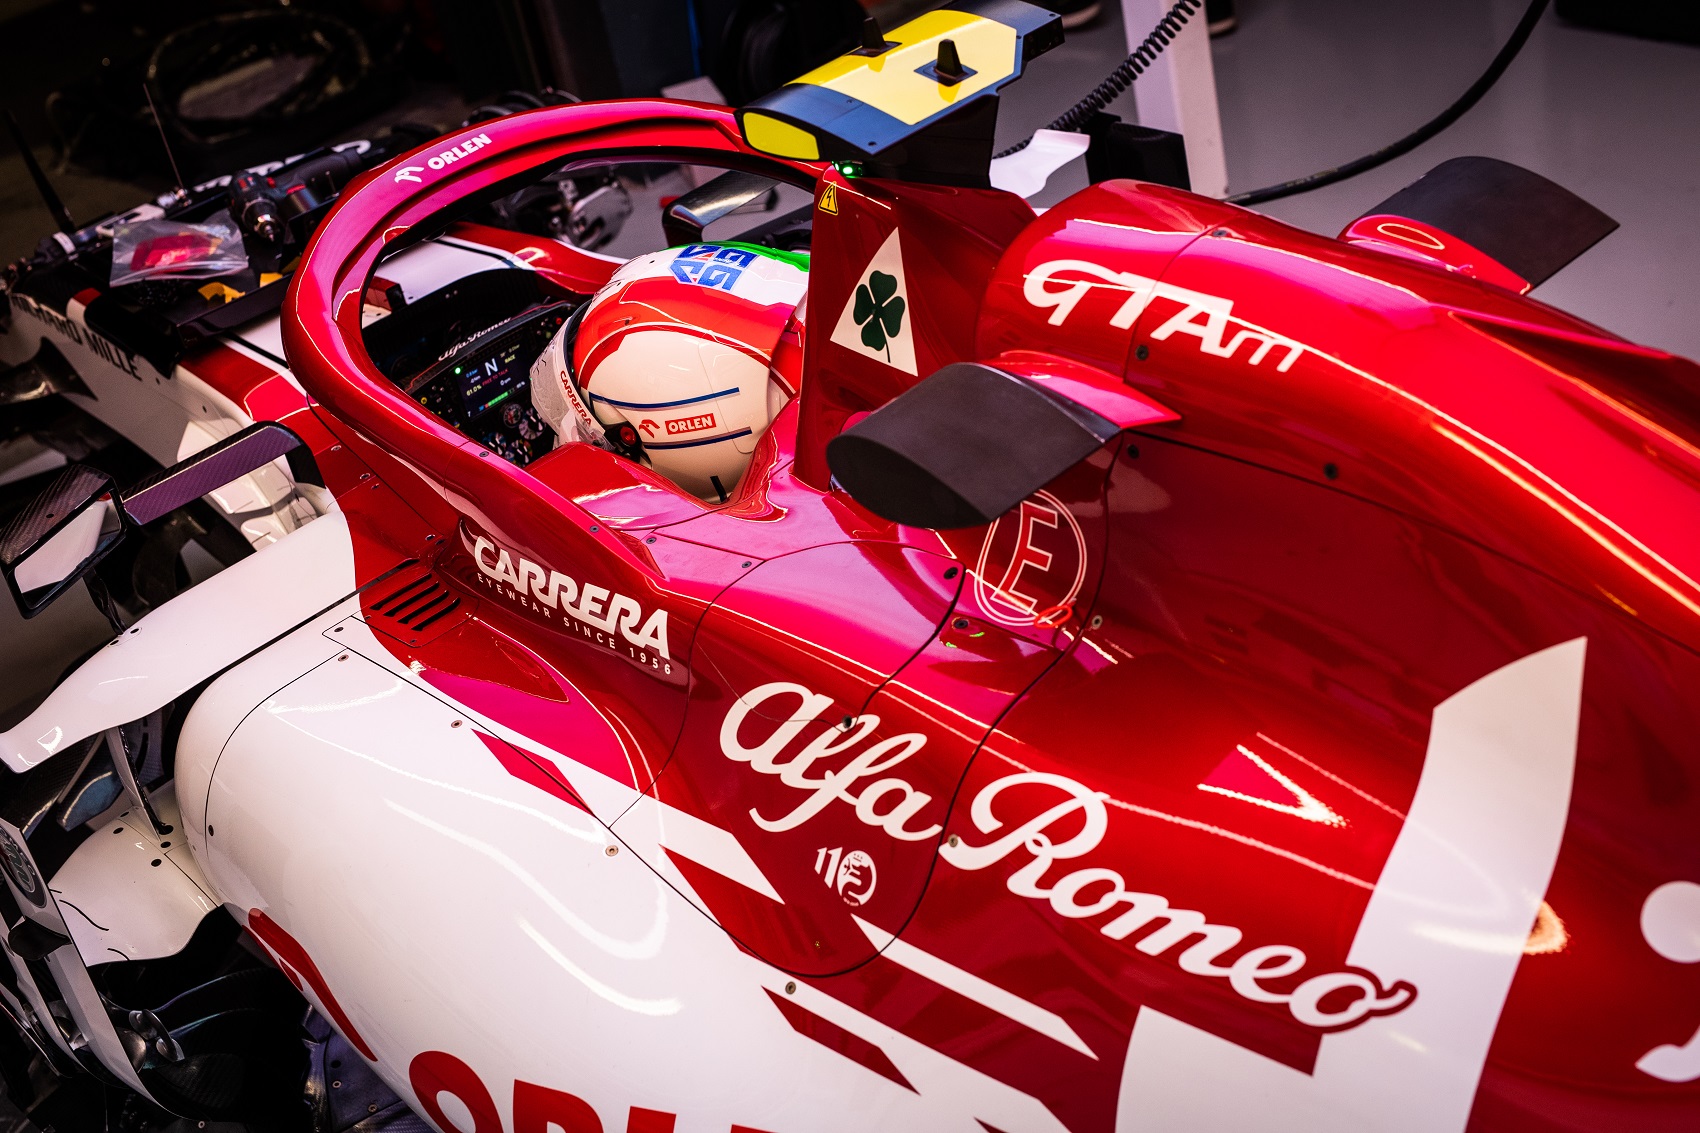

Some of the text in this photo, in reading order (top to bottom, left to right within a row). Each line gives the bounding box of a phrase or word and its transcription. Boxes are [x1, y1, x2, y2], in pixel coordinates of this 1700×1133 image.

[427, 133, 492, 170] ORLEN
[1023, 259, 1304, 372] GTAm
[484, 357, 499, 377] N
[560, 370, 592, 426] CARRERA
[667, 414, 714, 433] ORLEN
[474, 536, 671, 661] CARRERA
[989, 500, 1059, 616] E
[477, 573, 671, 675] EYEWEAR SINCE 1956
[719, 681, 944, 842] Alfa
[937, 771, 1413, 1030] Romeo
